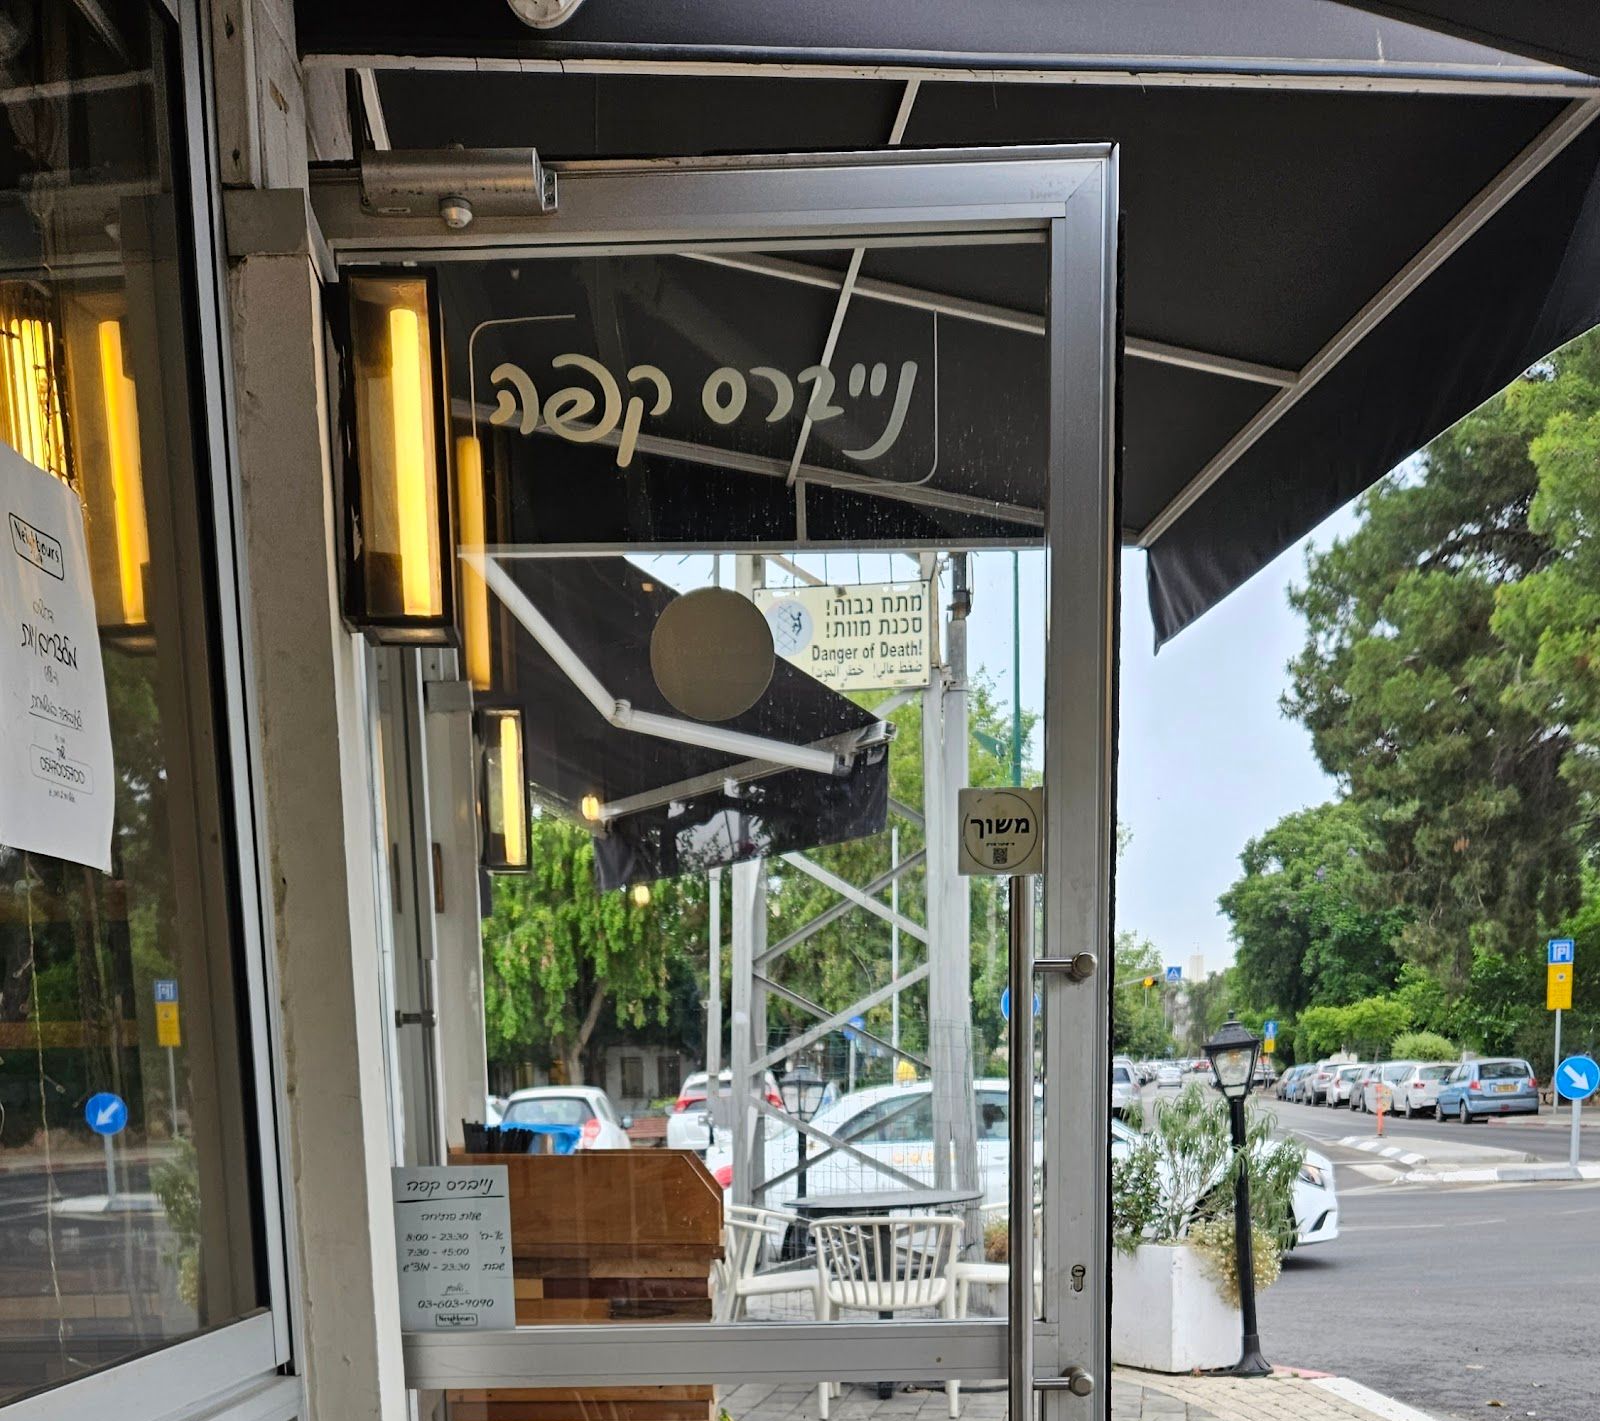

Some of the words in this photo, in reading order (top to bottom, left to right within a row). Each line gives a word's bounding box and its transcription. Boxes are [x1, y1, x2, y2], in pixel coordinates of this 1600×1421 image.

[489, 353, 673, 468] קפה
[701, 360, 918, 461] נייברס
[826, 598, 873, 616] גבוה!
[881, 594, 922, 613] מתח
[826, 620, 871, 638] מוות!
[878, 617, 922, 635] סכנת
[812, 645, 858, 664] Danger
[862, 642, 875, 659] of
[880, 639, 922, 658] Death!
[971, 818, 1029, 839] משוך
[406, 1181, 440, 1198] קפה
[446, 1179, 494, 1195] נייברס
[421, 1212, 456, 1221] פתיחה
[459, 1211, 481, 1221] שעות
[482, 1263, 505, 1271] שבת
[417, 1298, 495, 1309] 03-603-9090
